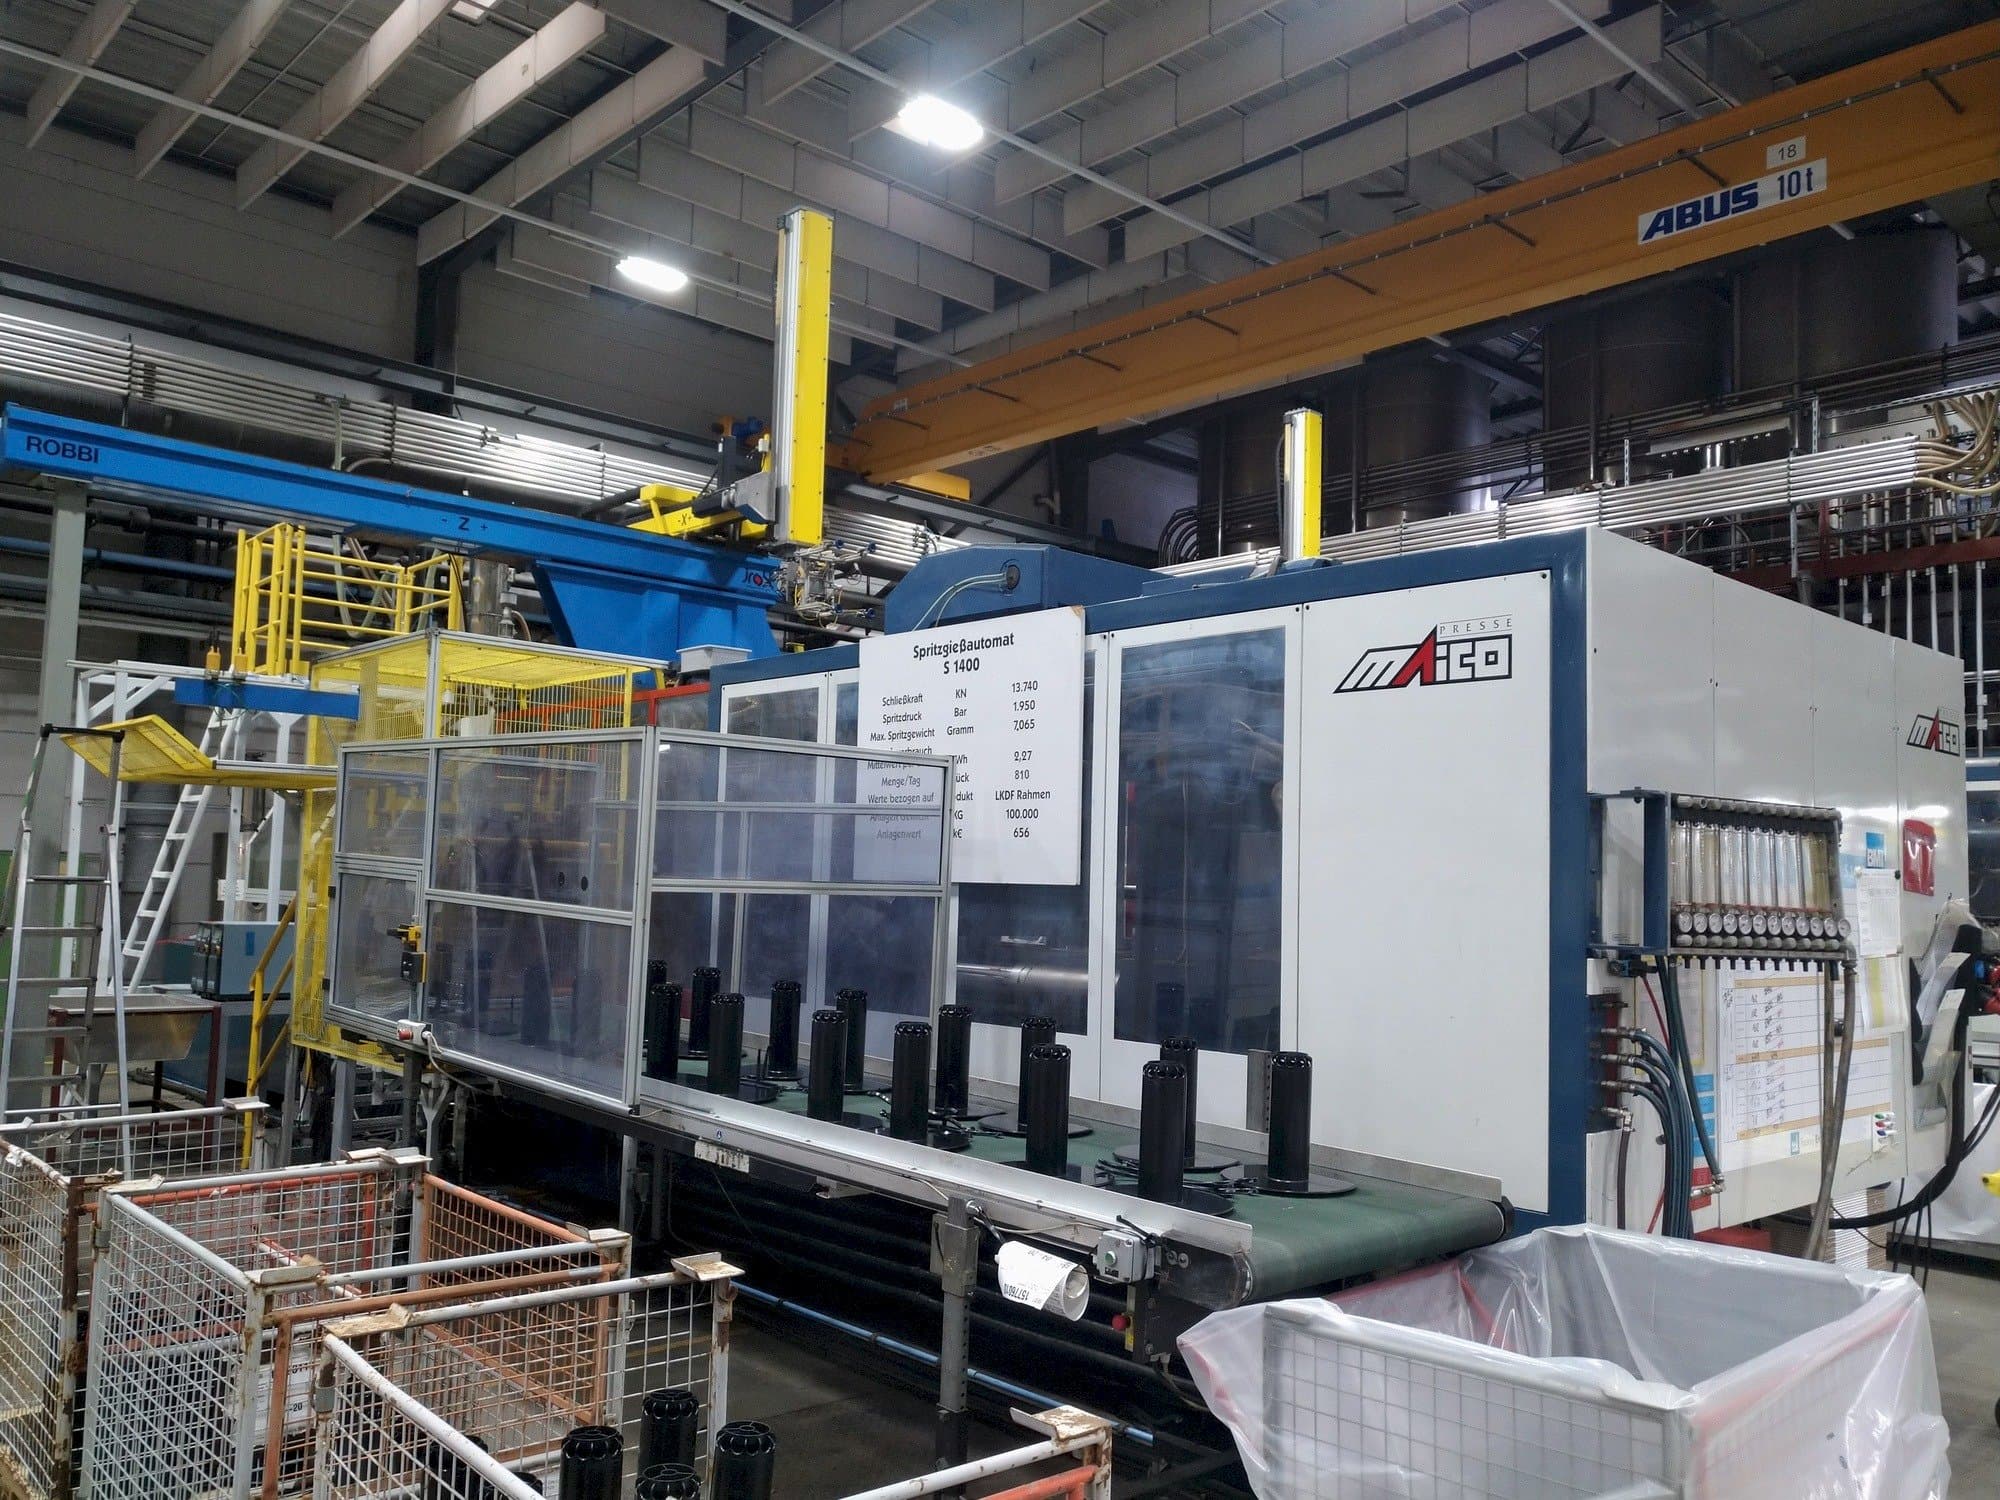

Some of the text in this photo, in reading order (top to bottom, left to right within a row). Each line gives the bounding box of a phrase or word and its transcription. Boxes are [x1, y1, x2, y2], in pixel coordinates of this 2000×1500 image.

[1778, 144, 1798, 161] 18
[1641, 167, 1814, 242] ABUS 10 t
[26, 435, 100, 464] ROBBI
[458, 516, 470, 531] Z
[1440, 618, 1513, 635] PRESSE
[913, 632, 1015, 660] Spritzgießautomat
[943, 657, 980, 675] S 1400
[882, 680, 1038, 707] Schließkraft KN 13.740
[882, 700, 1036, 724] Spritzdruck Bar 1.950
[870, 732, 886, 741] Max.
[888, 728, 935, 742] Spritzgewicht
[947, 726, 974, 736] Gramm
[1014, 751, 1032, 762] 2,27
[881, 774, 921, 788] Menge/Tag
[1014, 769, 1030, 780] 810
[867, 794, 888, 804] Werte
[889, 793, 920, 805] bezogen
[922, 791, 935, 802] auf
[995, 790, 1015, 801] LKDF
[1016, 788, 1051, 800] Rahmen
[1006, 808, 1039, 819] 100.000
[1013, 827, 1030, 838] 656
